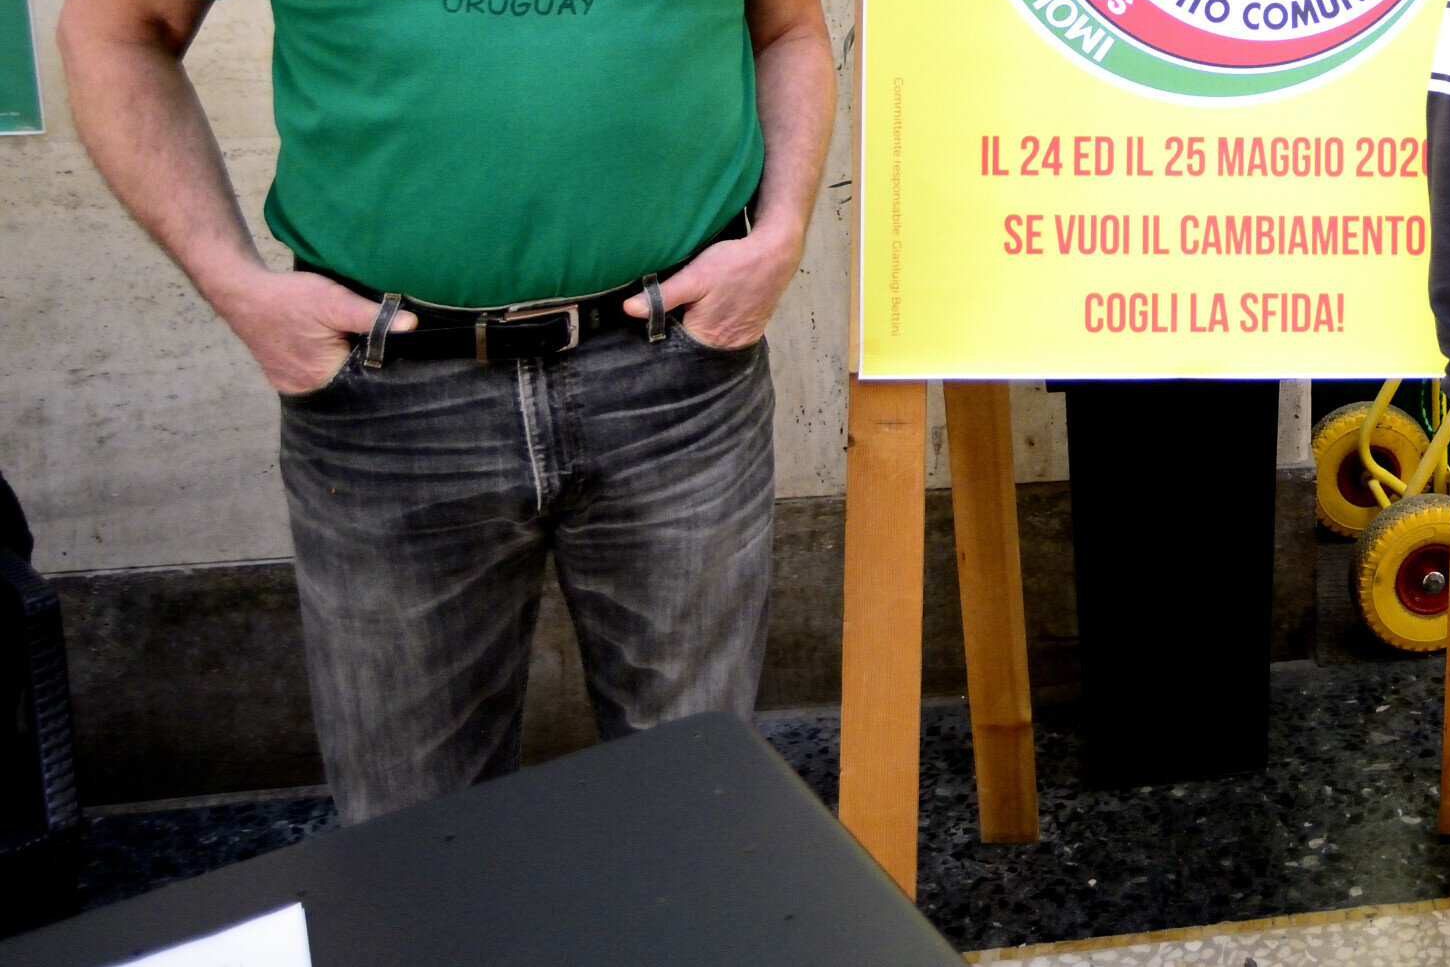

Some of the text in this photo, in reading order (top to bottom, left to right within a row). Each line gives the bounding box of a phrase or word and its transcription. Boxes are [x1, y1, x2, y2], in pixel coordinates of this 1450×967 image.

[892, 77, 904, 157] Committente
[981, 135, 1010, 176] IL
[1020, 135, 1063, 176] 24
[1073, 135, 1115, 177] ED
[1126, 136, 1154, 177] IL
[1164, 136, 1206, 177] 25
[1217, 136, 1344, 178] MAGGIO
[1003, 214, 1426, 256] SE VUOI IL CAMBIAMENTO
[890, 240, 902, 294] Gianluigi
[891, 297, 901, 336] Bettini
[1084, 292, 1344, 334] COGLI LA SFIDA!
